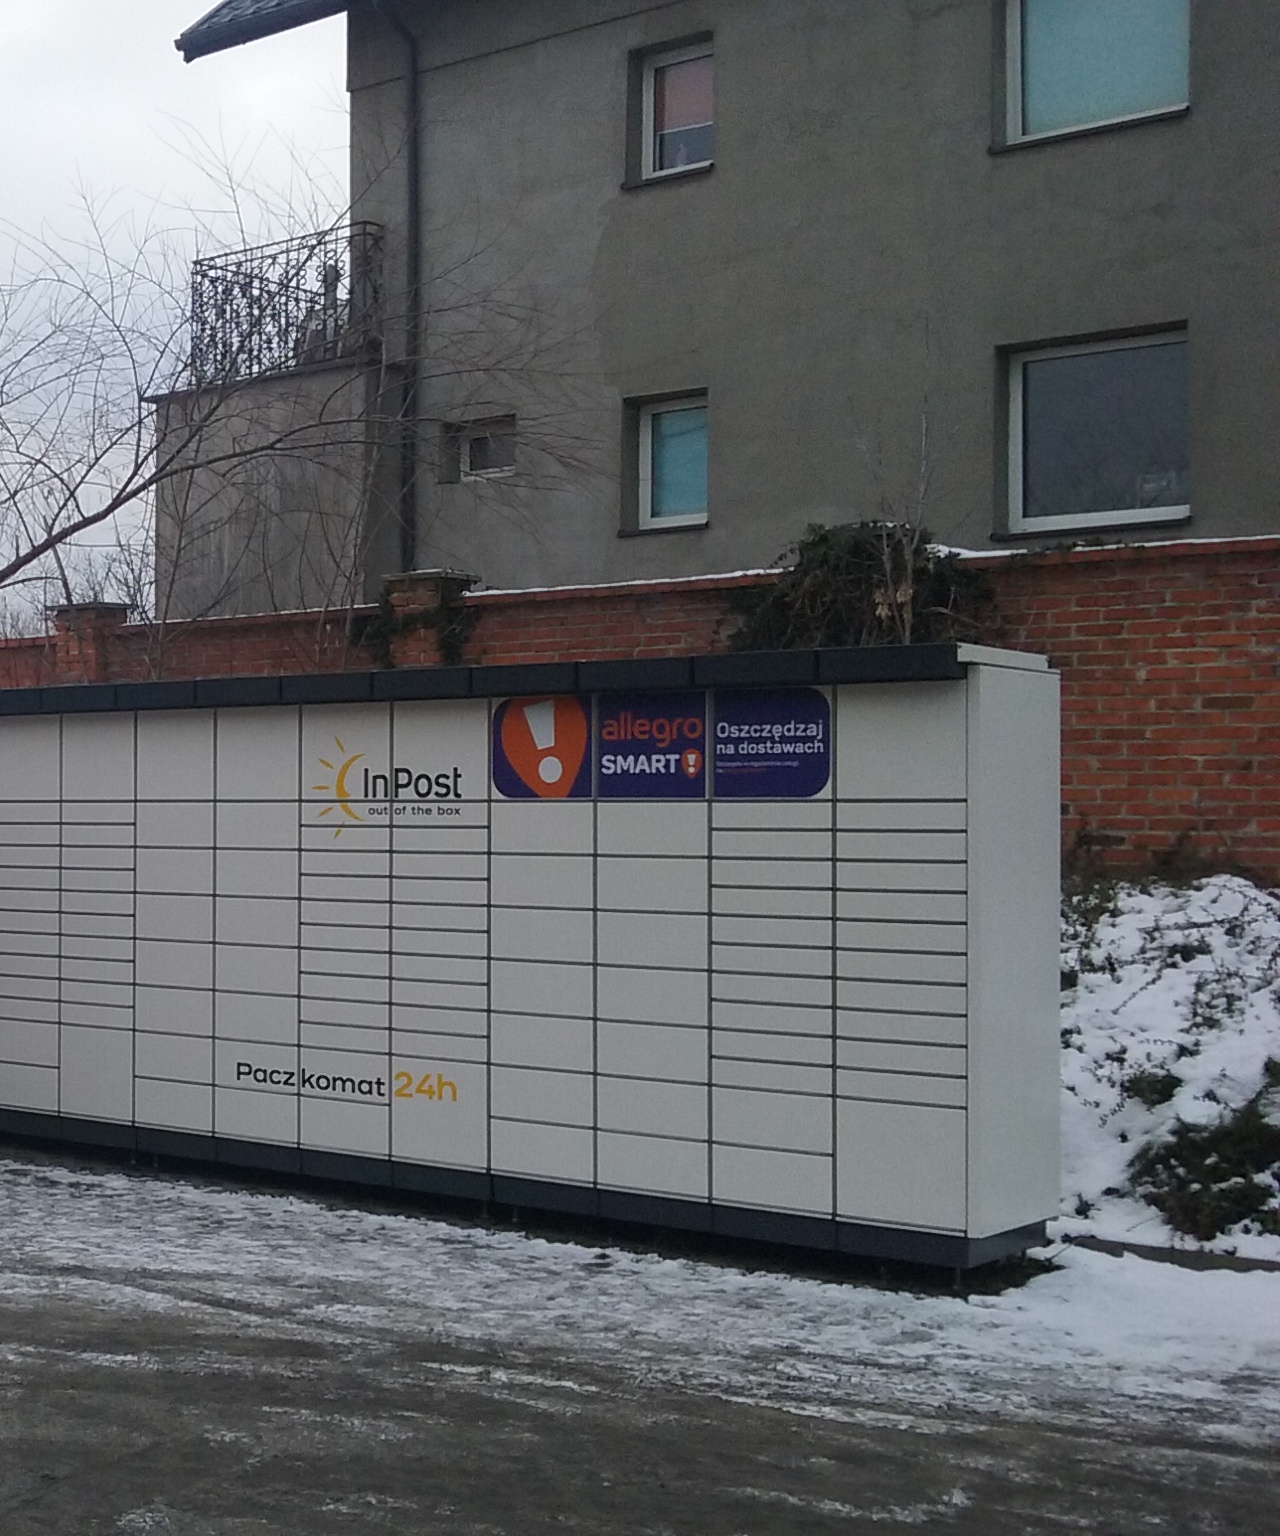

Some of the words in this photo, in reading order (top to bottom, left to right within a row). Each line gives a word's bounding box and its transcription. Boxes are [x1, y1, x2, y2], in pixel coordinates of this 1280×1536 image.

[601, 711, 703, 748] allegro
[716, 719, 824, 741] Oszczędzaj
[716, 743, 735, 755] na
[738, 740, 824, 754] dostawach
[363, 767, 462, 799] InPost
[368, 806, 389, 815] out
[394, 806, 407, 815] of
[411, 805, 433, 815] the
[437, 805, 461, 815] box
[236, 1062, 386, 1097] Paczkomat
[394, 1071, 458, 1102] 24h
